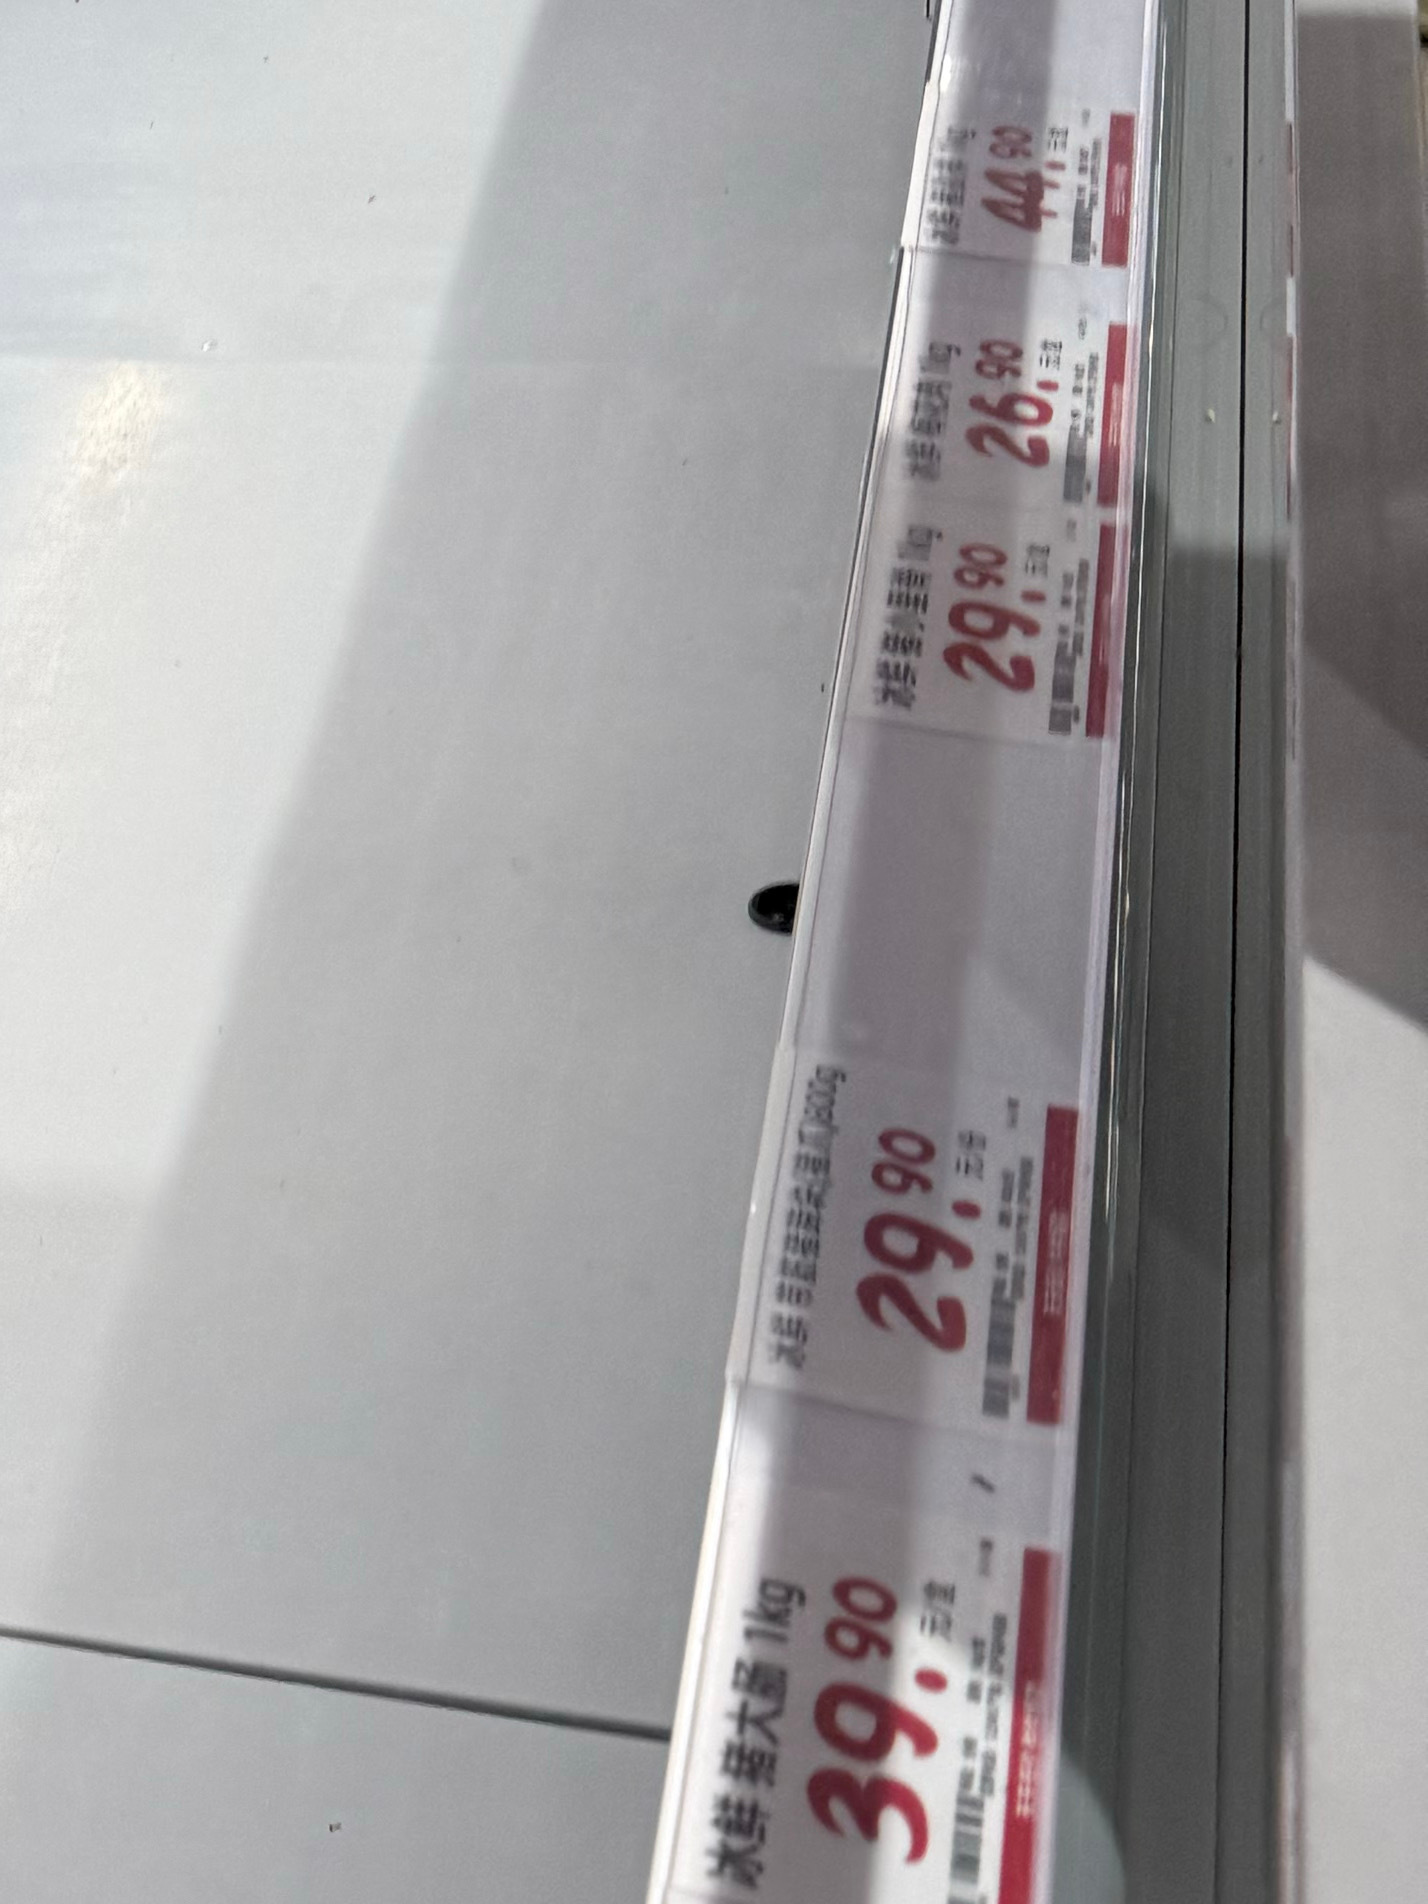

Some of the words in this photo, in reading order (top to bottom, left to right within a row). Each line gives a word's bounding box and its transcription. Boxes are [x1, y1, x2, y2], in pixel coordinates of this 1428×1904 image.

[856, 1126, 982, 1353] 29.90
[706, 1793, 769, 1893] 冰鲜
[742, 1577, 808, 1645] 1kg
[805, 1575, 949, 1866] 39.90
